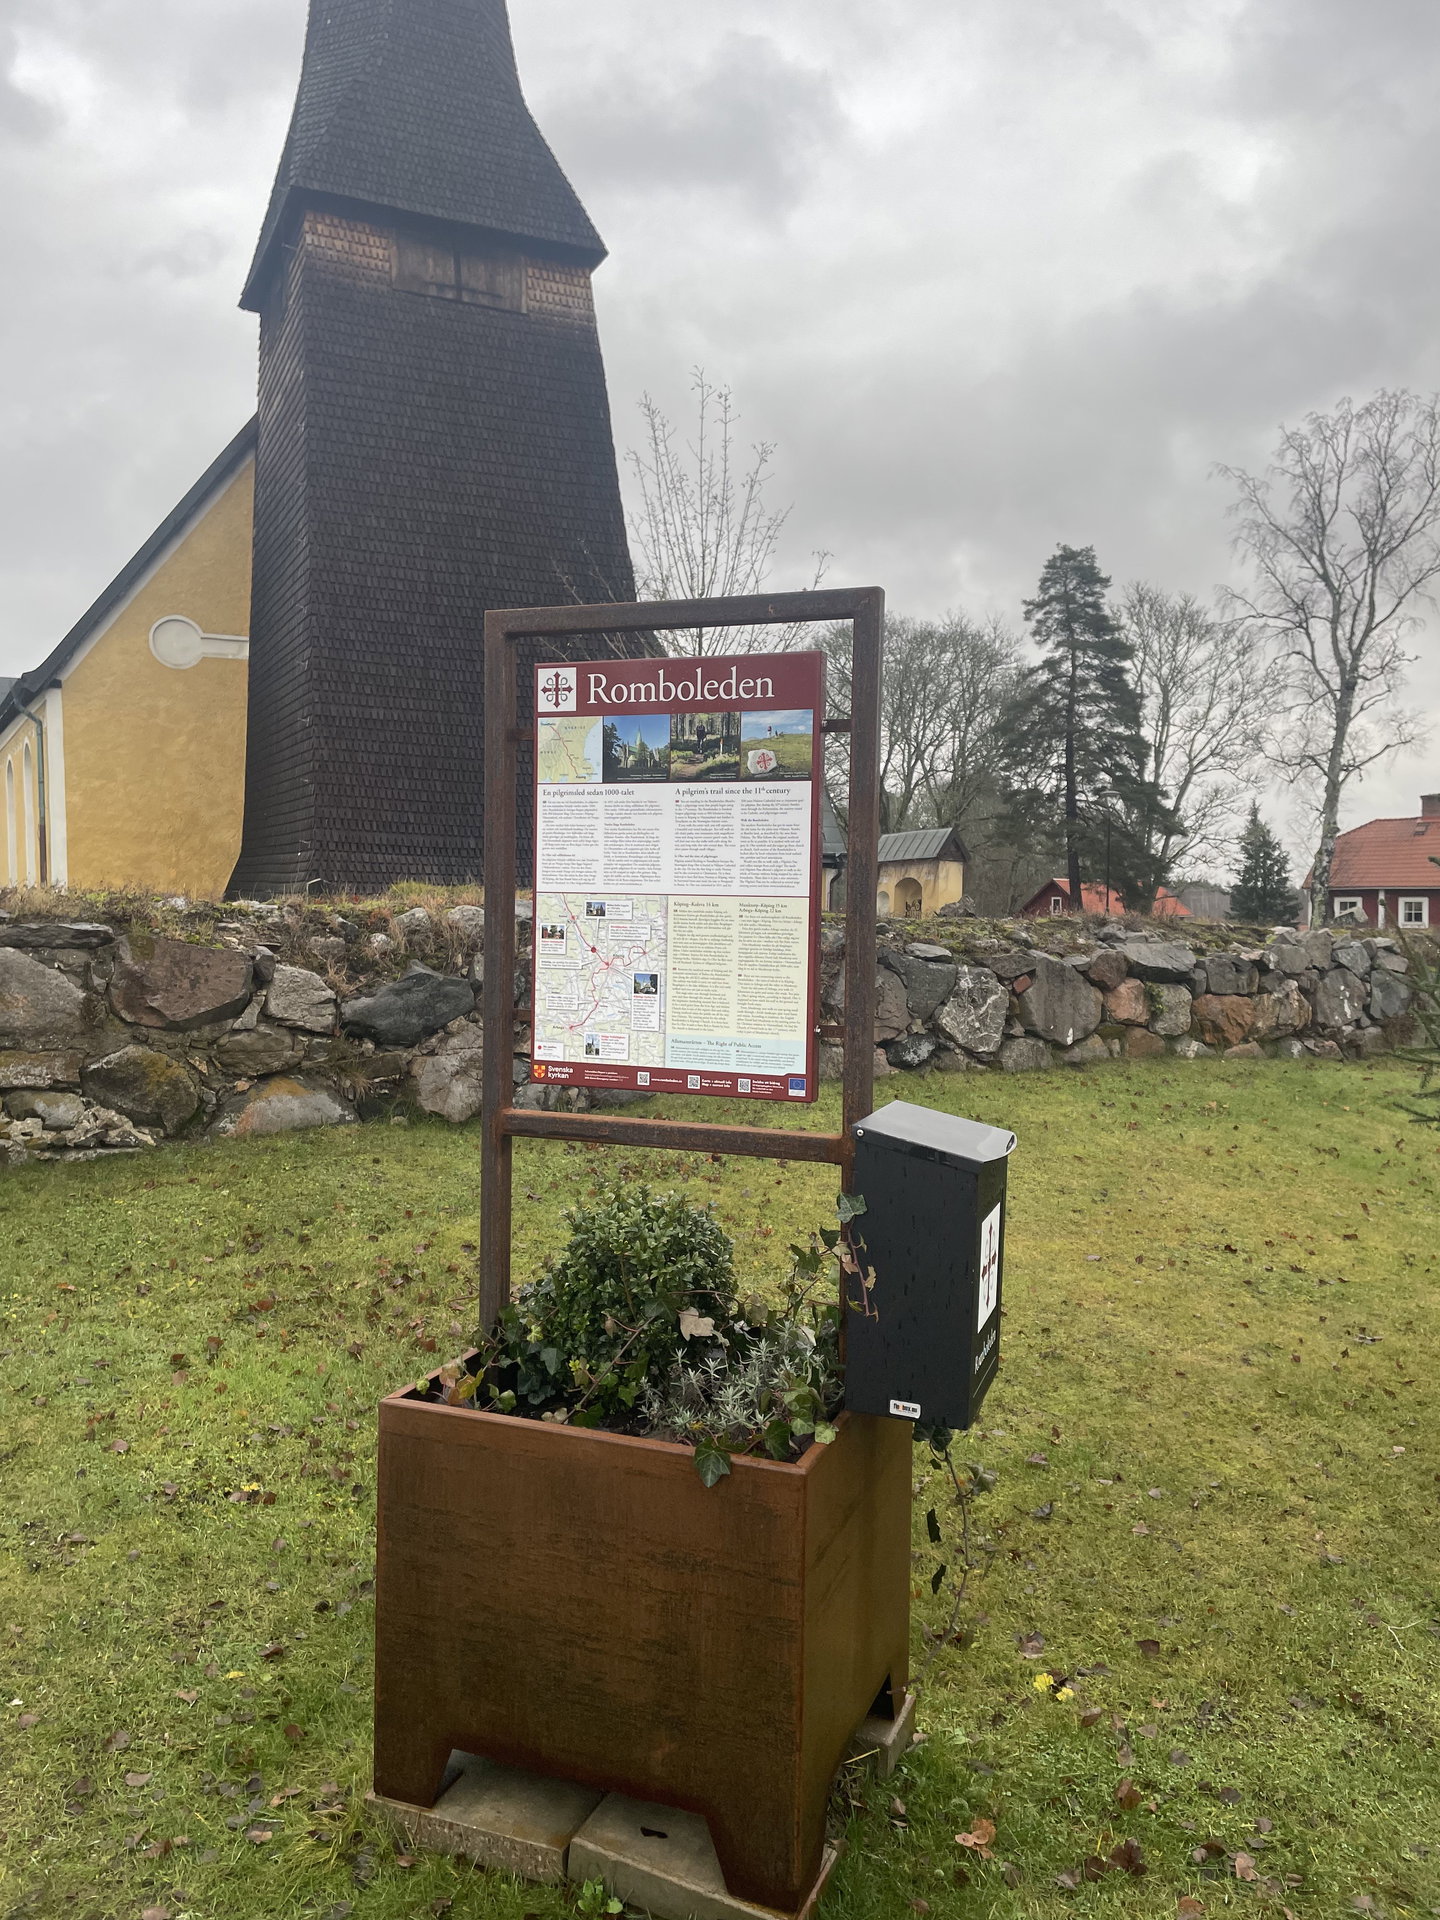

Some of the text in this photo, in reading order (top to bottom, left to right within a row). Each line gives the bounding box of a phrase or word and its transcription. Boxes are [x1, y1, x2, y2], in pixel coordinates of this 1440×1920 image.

[586, 665, 775, 704] Romboleden
[552, 788, 586, 798] pilgrimsled
[710, 787, 724, 795] trail
[742, 786, 752, 794] the
[766, 787, 790, 797] century
[548, 1065, 573, 1073] Svenska
